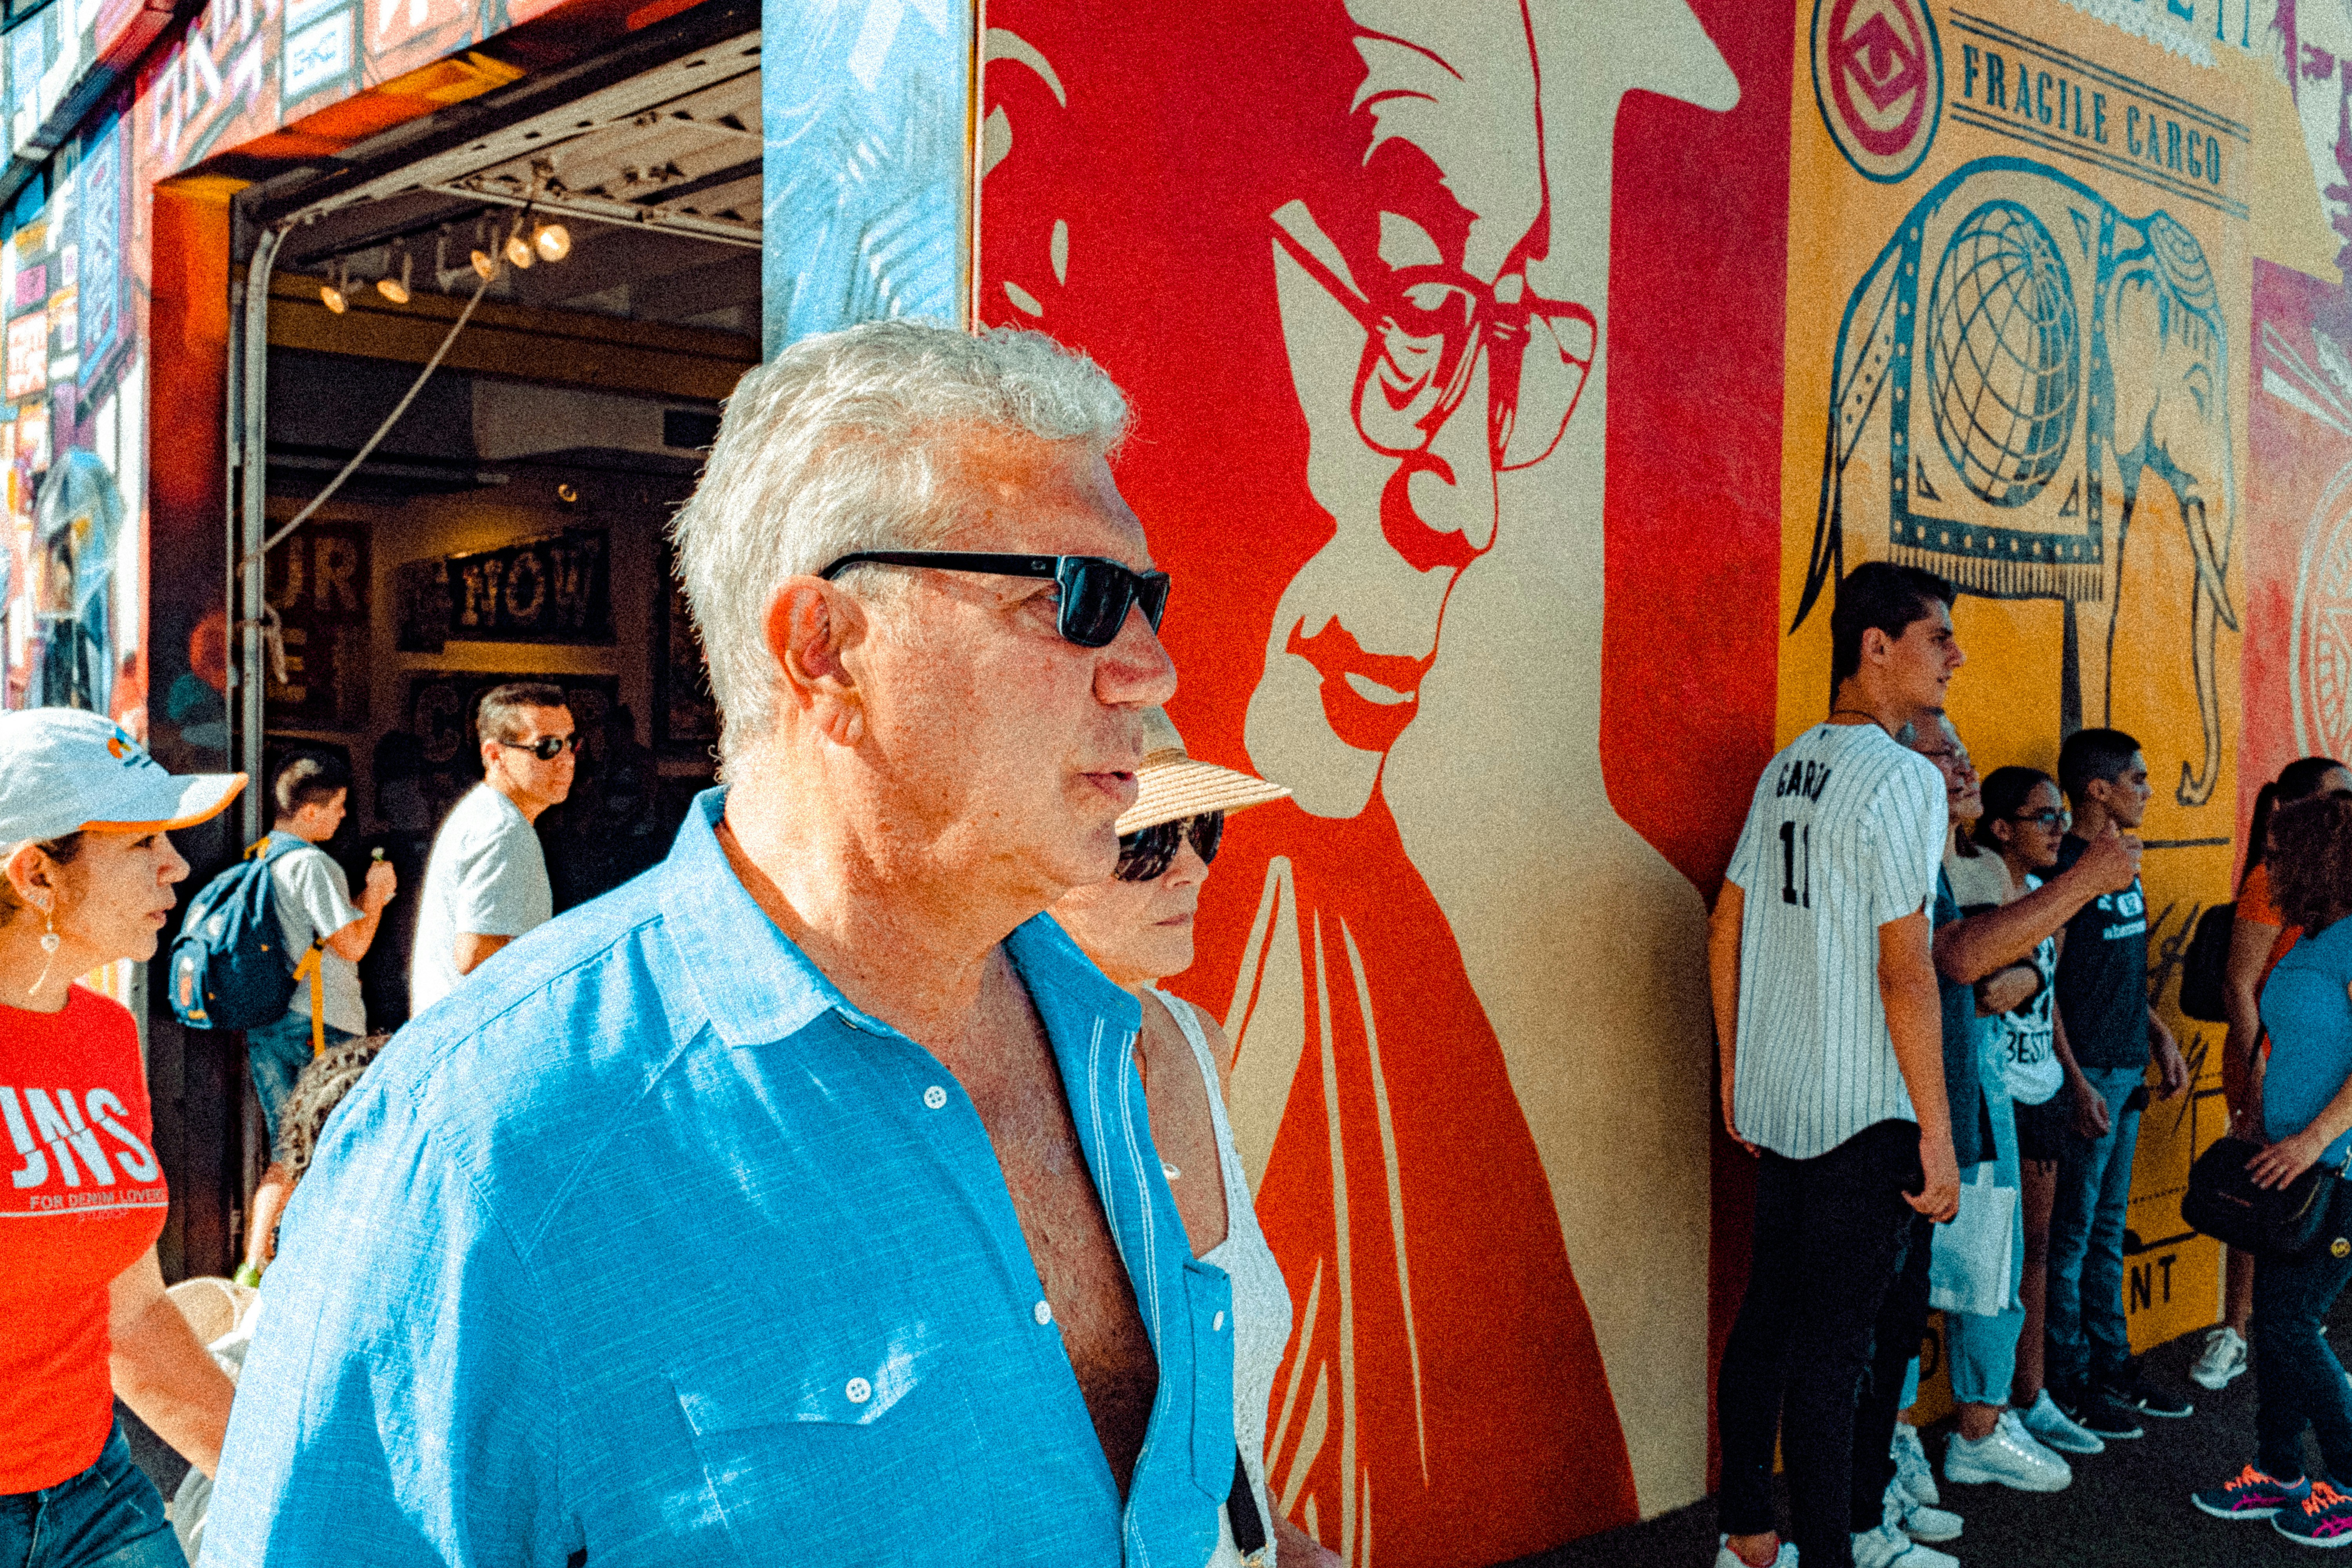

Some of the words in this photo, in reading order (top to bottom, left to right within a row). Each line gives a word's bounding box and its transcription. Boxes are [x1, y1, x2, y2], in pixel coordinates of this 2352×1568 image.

[1961, 43, 2108, 143] FRAGILE
[2126, 103, 2221, 185] CARGO
[460, 543, 596, 627] NOW
[30, 1194, 64, 1210] FOR
[69, 1192, 114, 1207] DENIM
